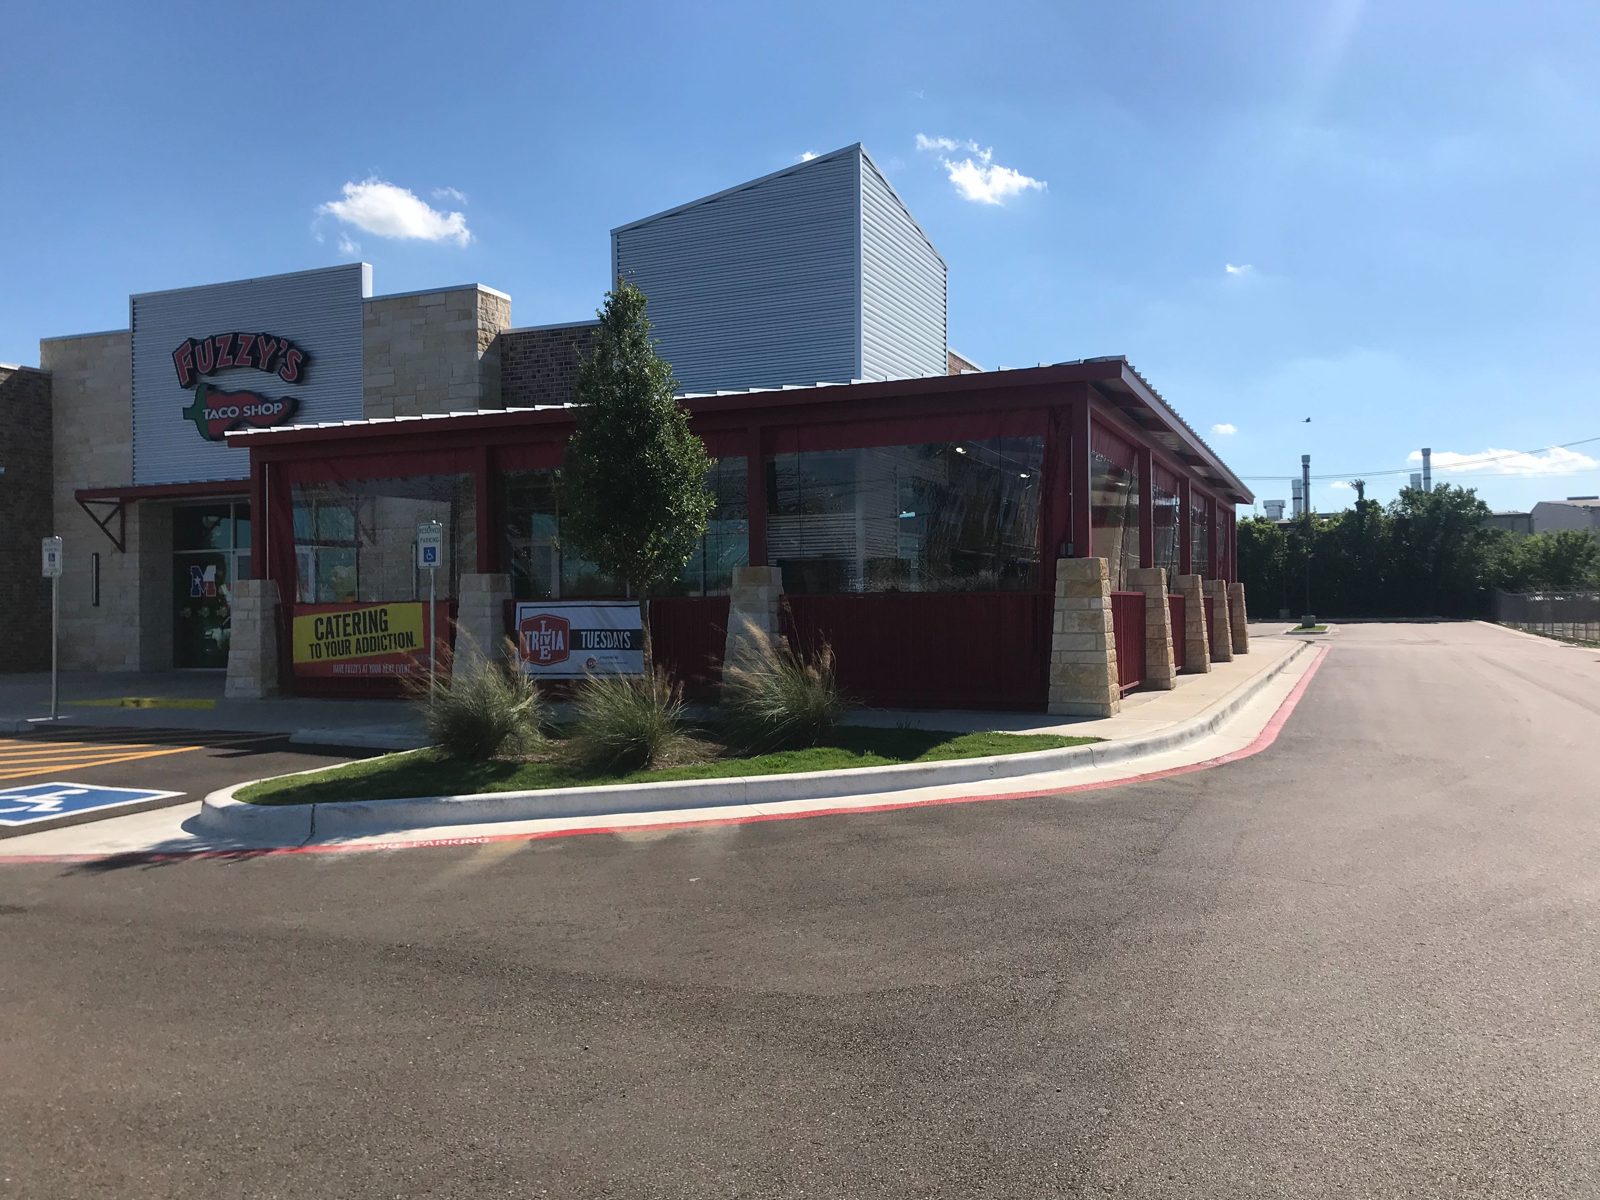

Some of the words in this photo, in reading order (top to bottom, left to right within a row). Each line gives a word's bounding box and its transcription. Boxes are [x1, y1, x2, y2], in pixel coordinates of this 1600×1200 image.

[172, 332, 303, 387] FUZZY'S
[203, 406, 240, 420] TACO
[243, 402, 283, 418] SHOP
[315, 608, 388, 641] CATERING
[308, 643, 321, 660] TO
[324, 640, 351, 658] YOUR
[355, 631, 417, 655] ADDICTION.
[581, 631, 631, 649] TUESDAYS
[362, 663, 368, 674] AT
[369, 663, 382, 674] YOUR
[412, 837, 490, 848] PARKING
